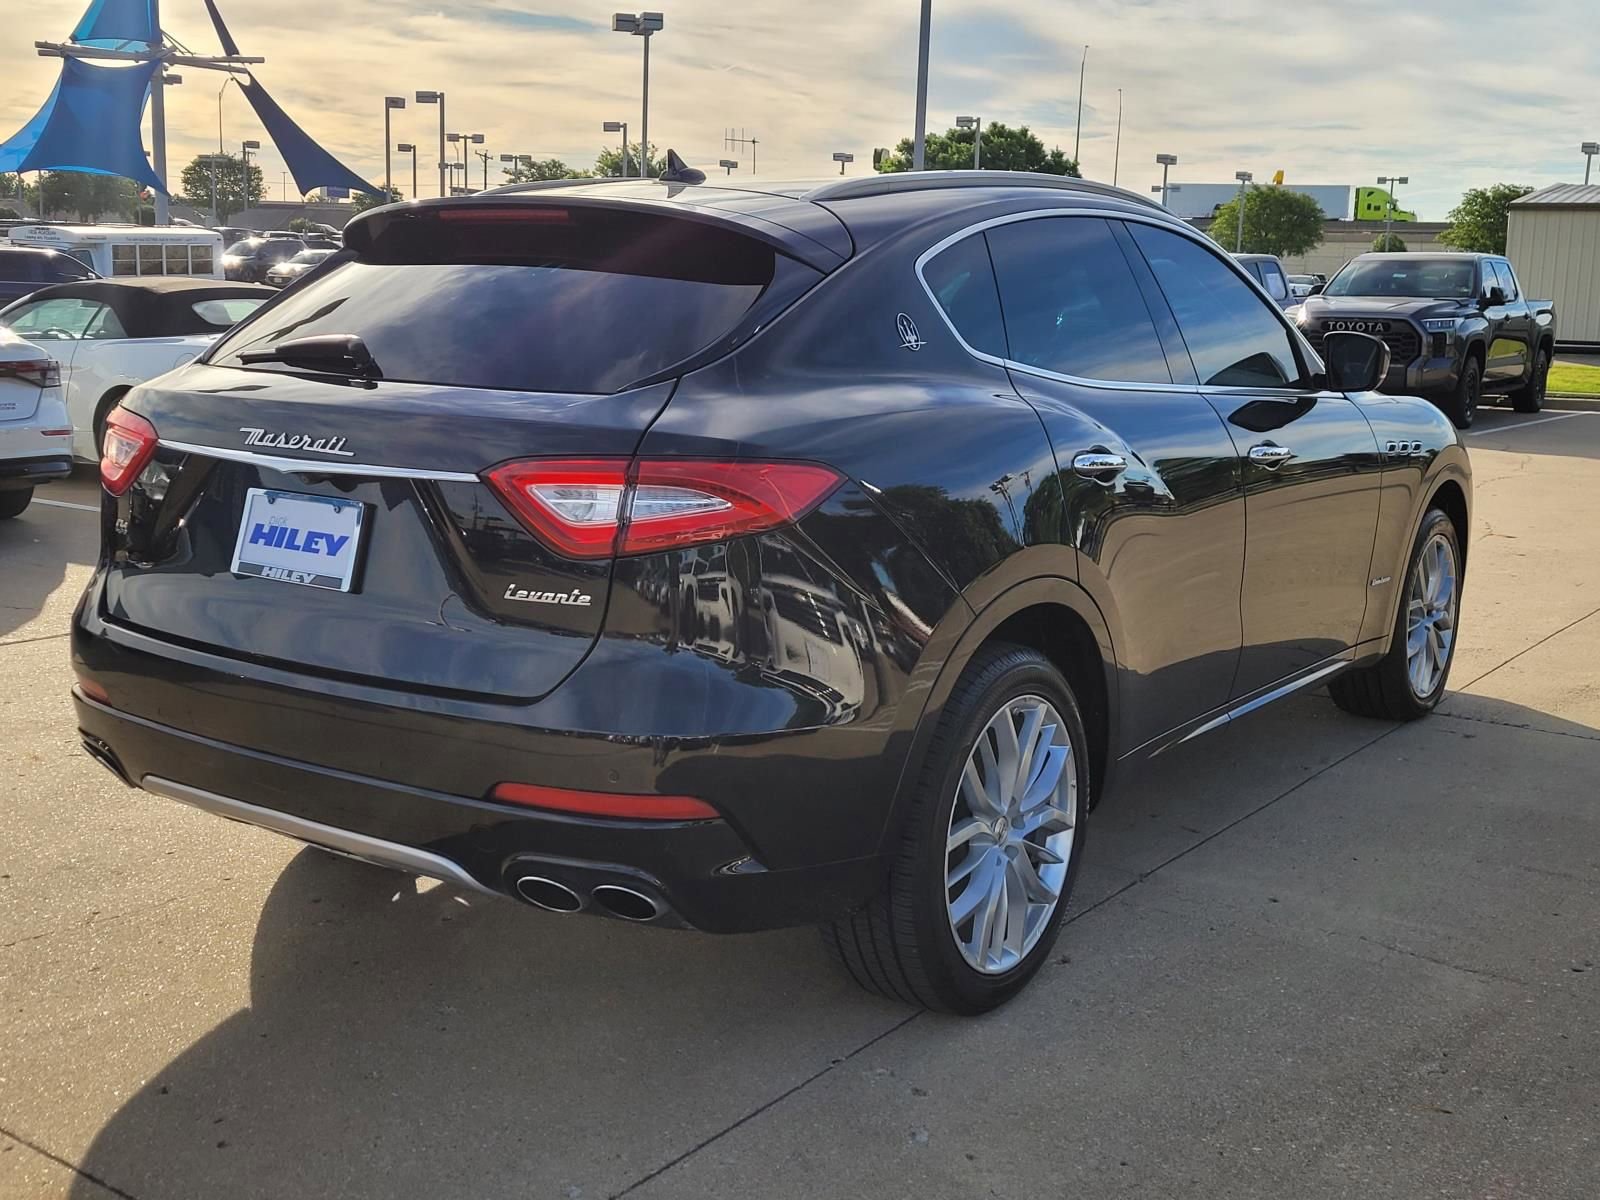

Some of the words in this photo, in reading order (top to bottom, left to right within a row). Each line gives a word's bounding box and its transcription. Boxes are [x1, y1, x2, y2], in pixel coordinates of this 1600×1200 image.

[1328, 321, 1384, 332] TOYOTA
[240, 427, 354, 456] Maserati
[249, 523, 349, 556] HILEY
[261, 566, 317, 584] HILEY
[504, 583, 591, 606] Levante
